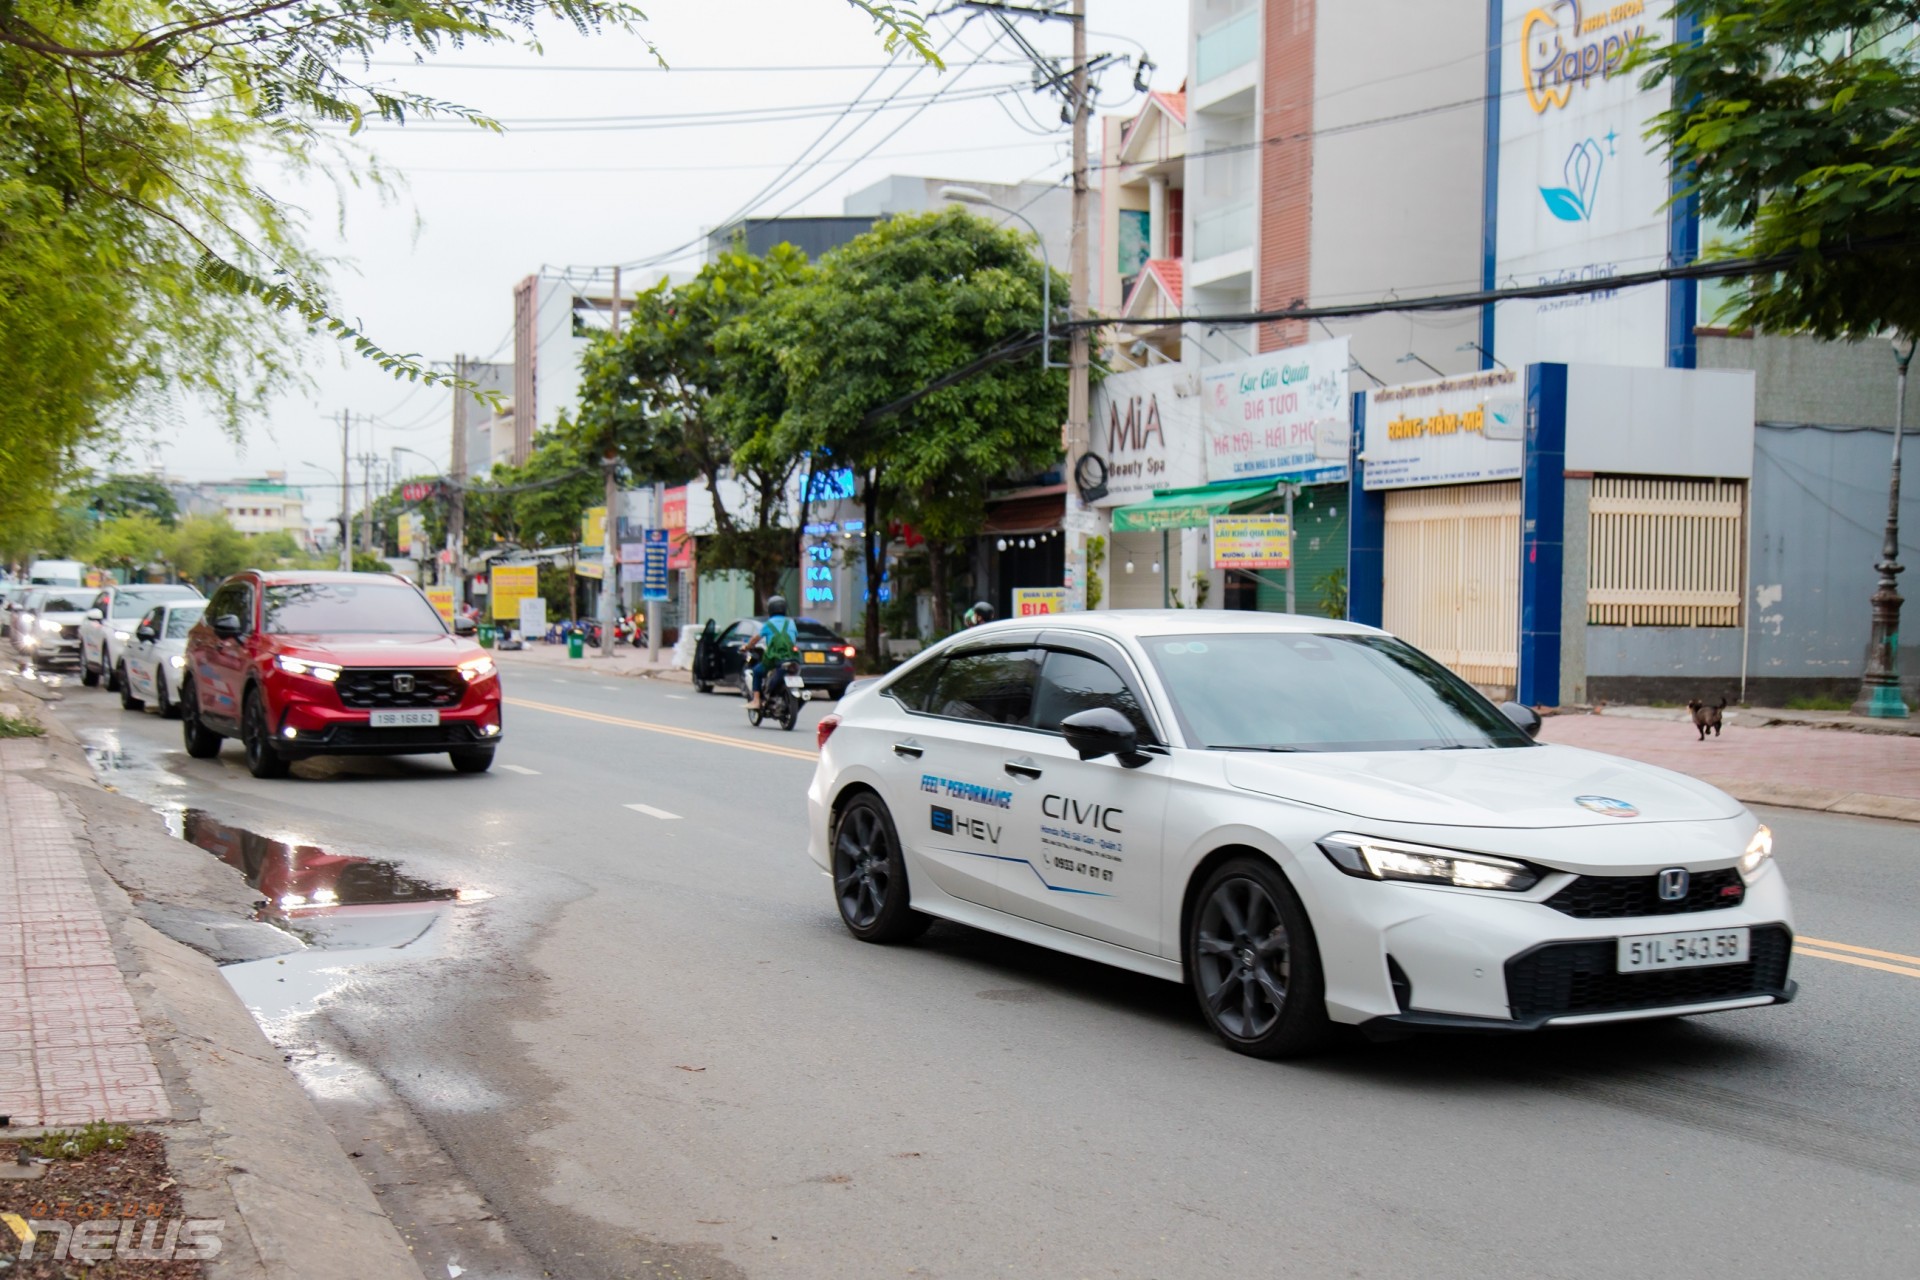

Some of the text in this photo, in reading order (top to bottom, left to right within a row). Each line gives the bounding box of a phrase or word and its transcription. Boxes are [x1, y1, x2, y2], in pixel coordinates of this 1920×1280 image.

[1582, 11, 1607, 33] NHA
[1244, 398, 1265, 421] BIA
[1109, 393, 1165, 453] MiA
[1109, 457, 1166, 478] Beauty Spa
[807, 566, 832, 581] KA
[1021, 602, 1051, 616] BIA
[921, 775, 939, 793] FEEL
[946, 779, 1013, 810] PERFORMANCE
[1042, 794, 1124, 834] CIVIC
